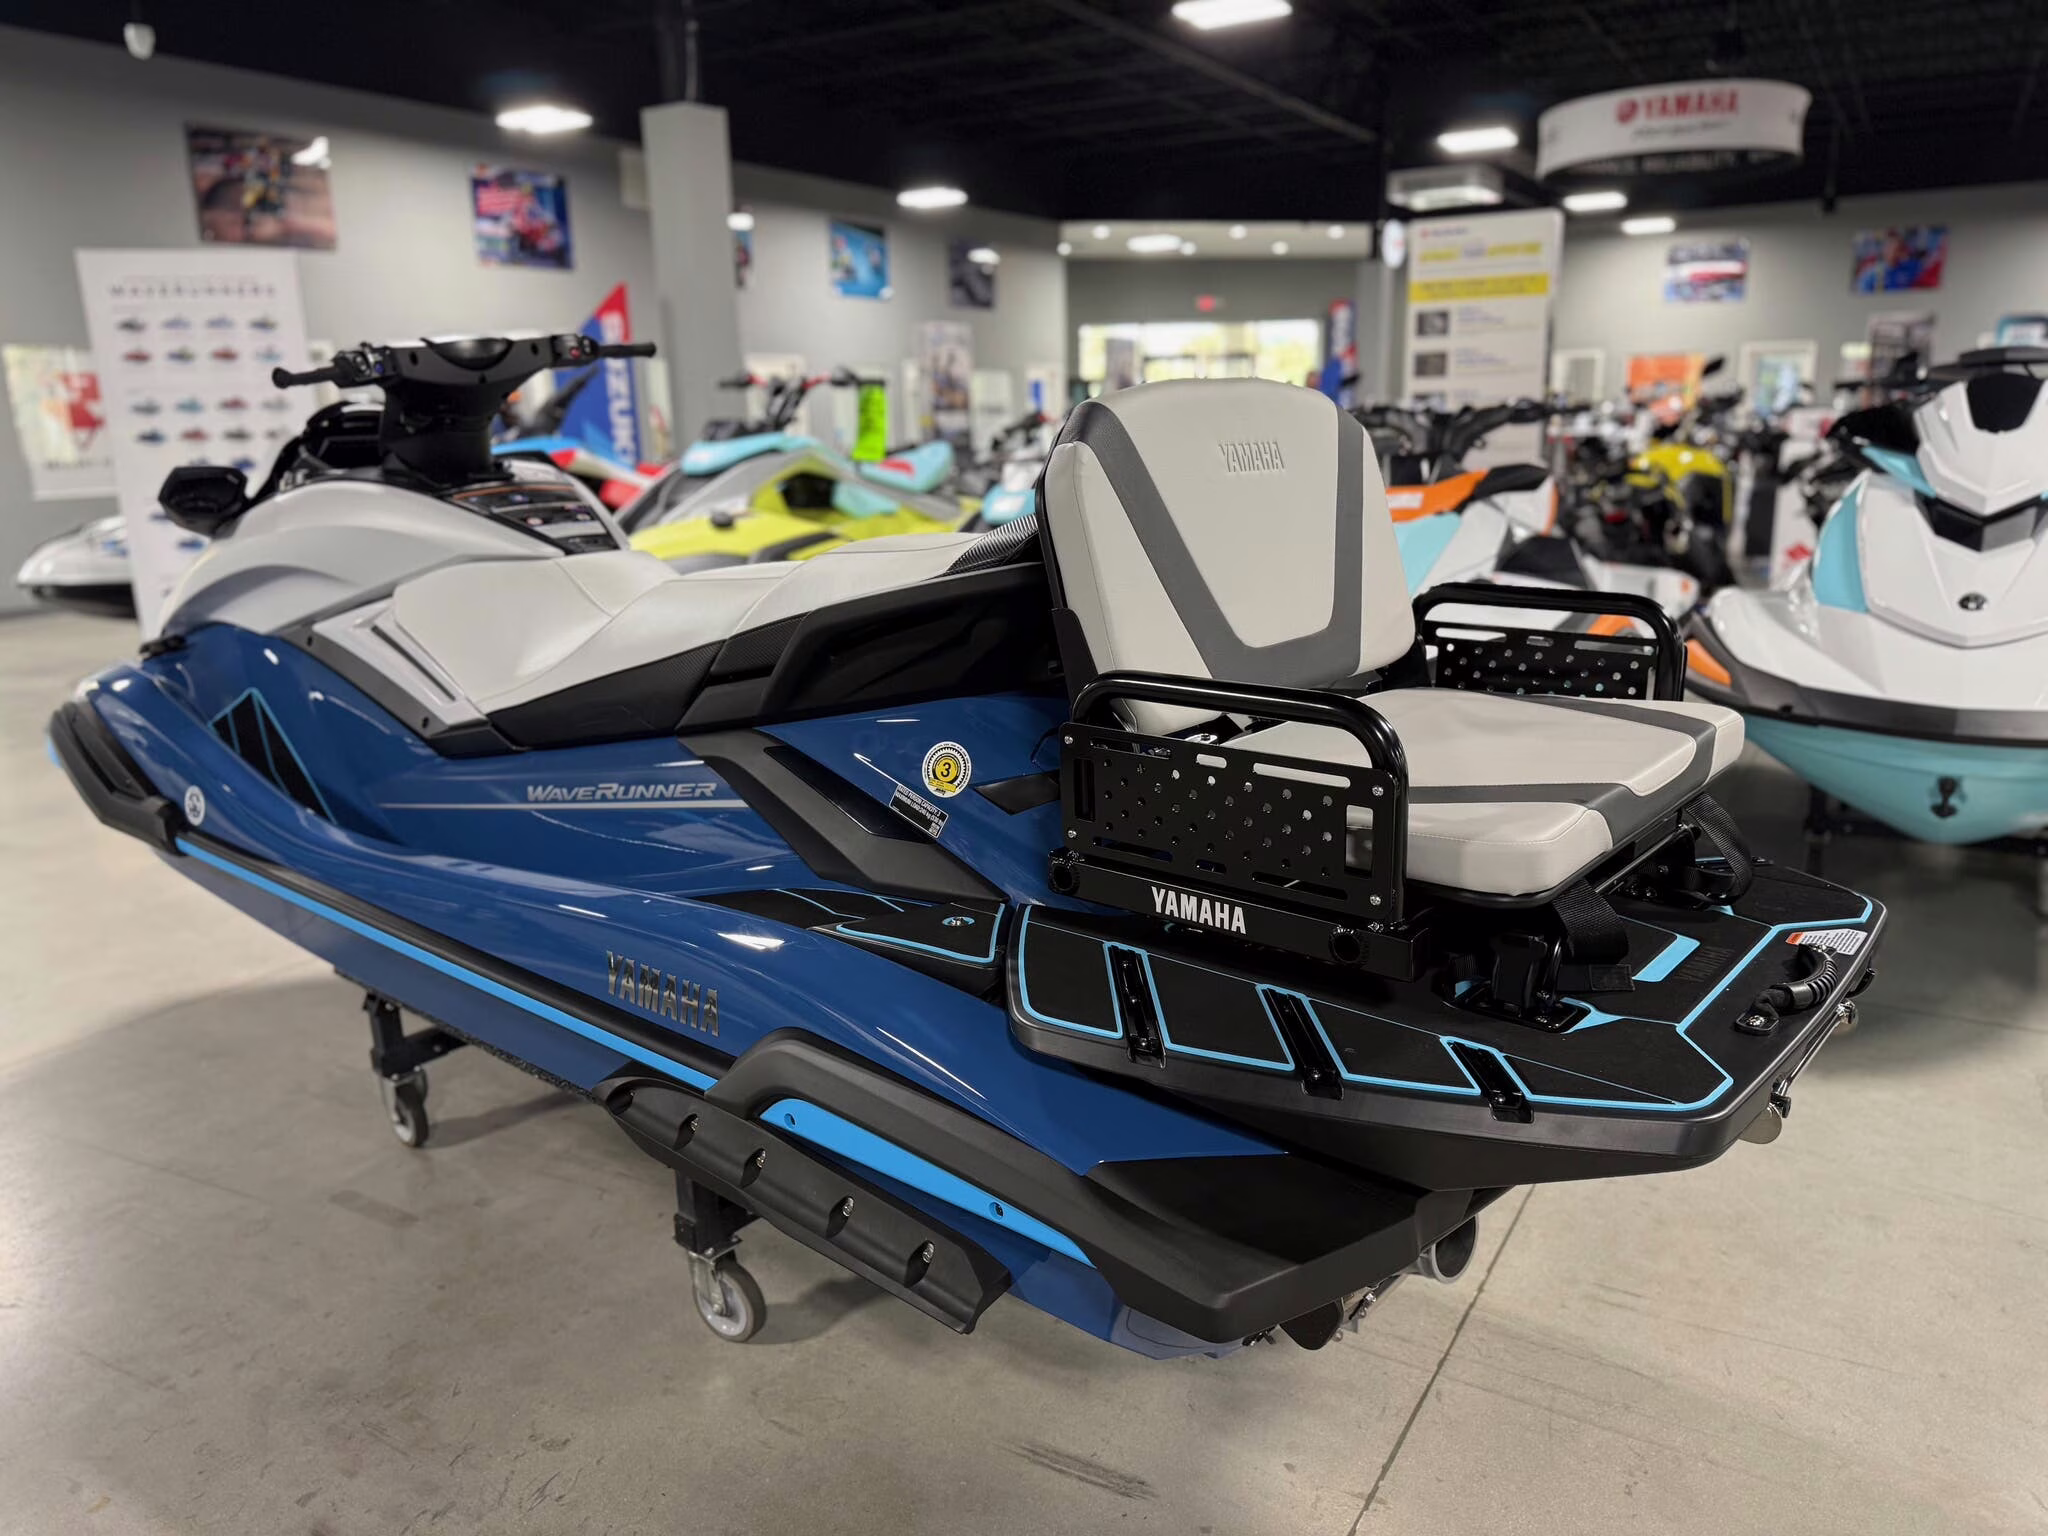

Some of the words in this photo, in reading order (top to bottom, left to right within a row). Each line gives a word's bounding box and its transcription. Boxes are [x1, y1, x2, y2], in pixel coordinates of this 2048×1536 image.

[1643, 89, 1740, 119] YAMAHA
[1218, 440, 1285, 473] YAMAHA
[940, 761, 952, 778] 3
[526, 782, 718, 801] WAVERUNNER
[1151, 885, 1247, 935] YAMAHA
[605, 949, 720, 1037] YAMAHA
